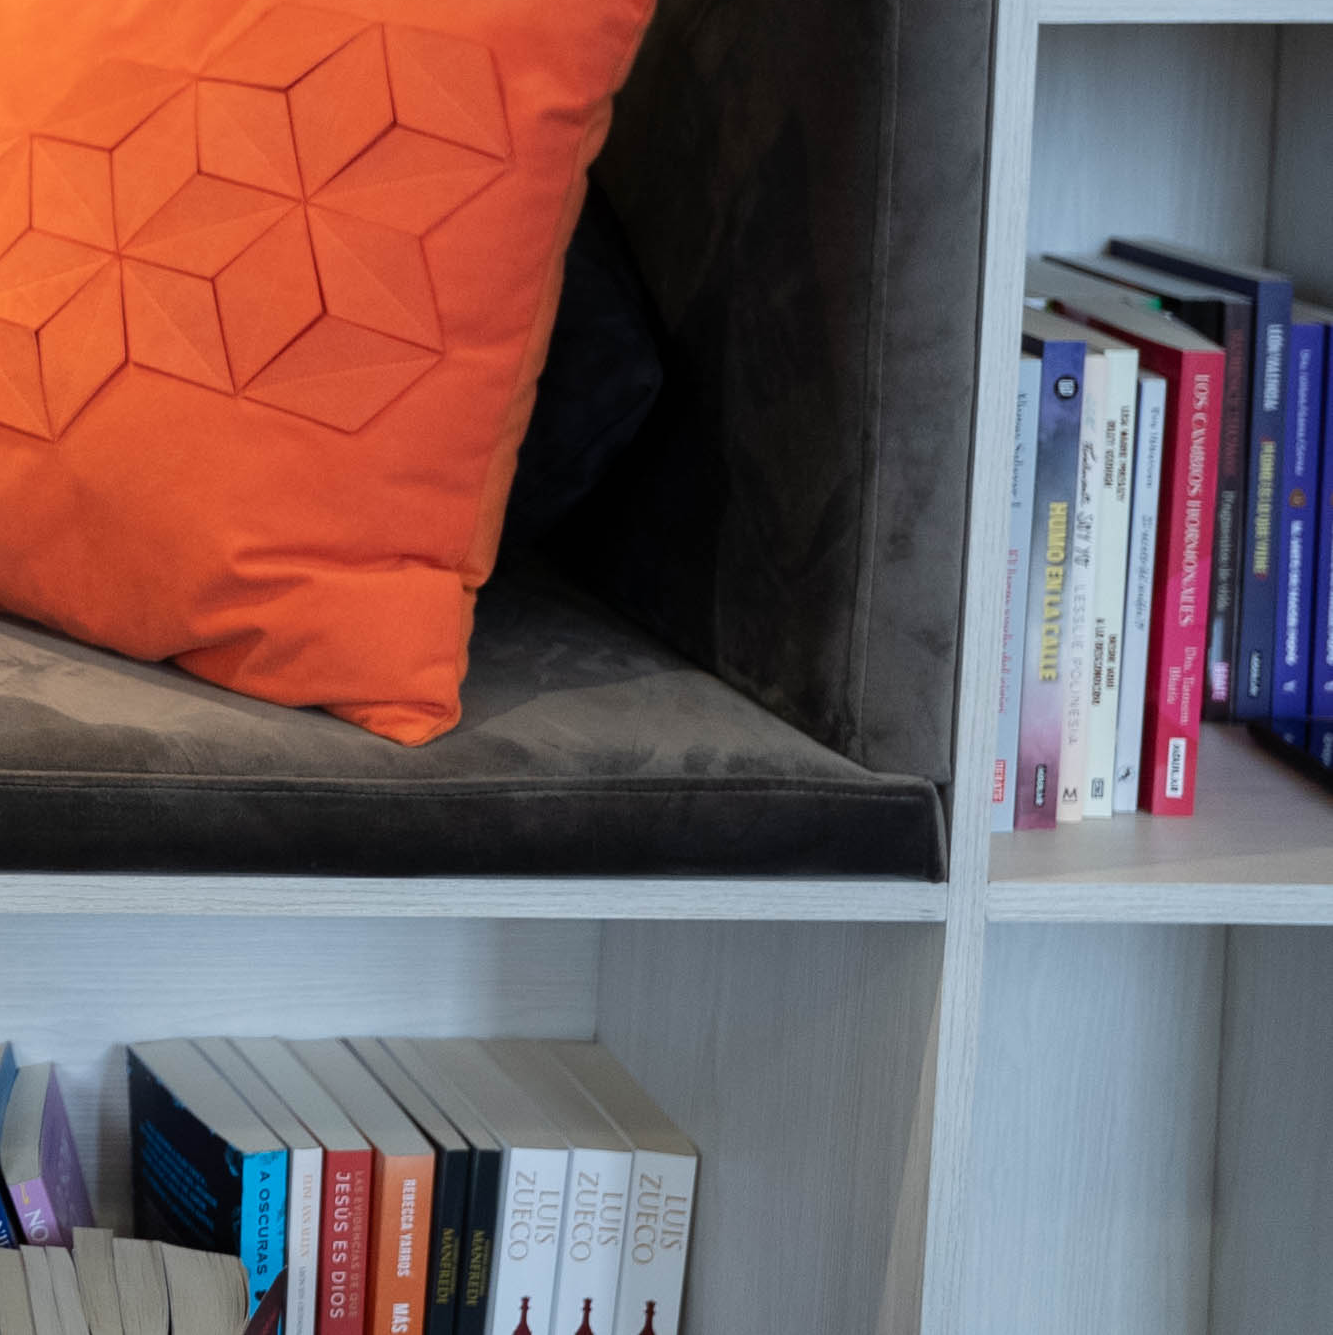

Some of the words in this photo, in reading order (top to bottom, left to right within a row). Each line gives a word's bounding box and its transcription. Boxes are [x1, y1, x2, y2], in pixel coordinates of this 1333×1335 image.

[1194, 374, 1211, 408] LOS
[1187, 412, 1209, 496] CAMBIOS
[1046, 501, 1067, 562] HUMO
[1177, 499, 1202, 627] HORMONALES
[1039, 624, 1062, 682] CALLE
[333, 1171, 353, 1232] JESÚS
[400, 1178, 417, 1231] REBECCA
[507, 1170, 537, 1261] ZUECO
[534, 1191, 560, 1244] LUIS
[569, 1171, 600, 1261] ZUECO
[597, 1193, 623, 1245] LUIS
[632, 1172, 663, 1265] ZUECO
[660, 1195, 687, 1249] LUIS
[256, 1187, 270, 1276] OSCURAS
[332, 1240, 348, 1264] ES
[351, 1197, 364, 1268] EVIDENCIAS
[396, 1233, 413, 1277] YARROS
[329, 1271, 348, 1319] DIOS
[391, 1302, 412, 1334] MÁS
